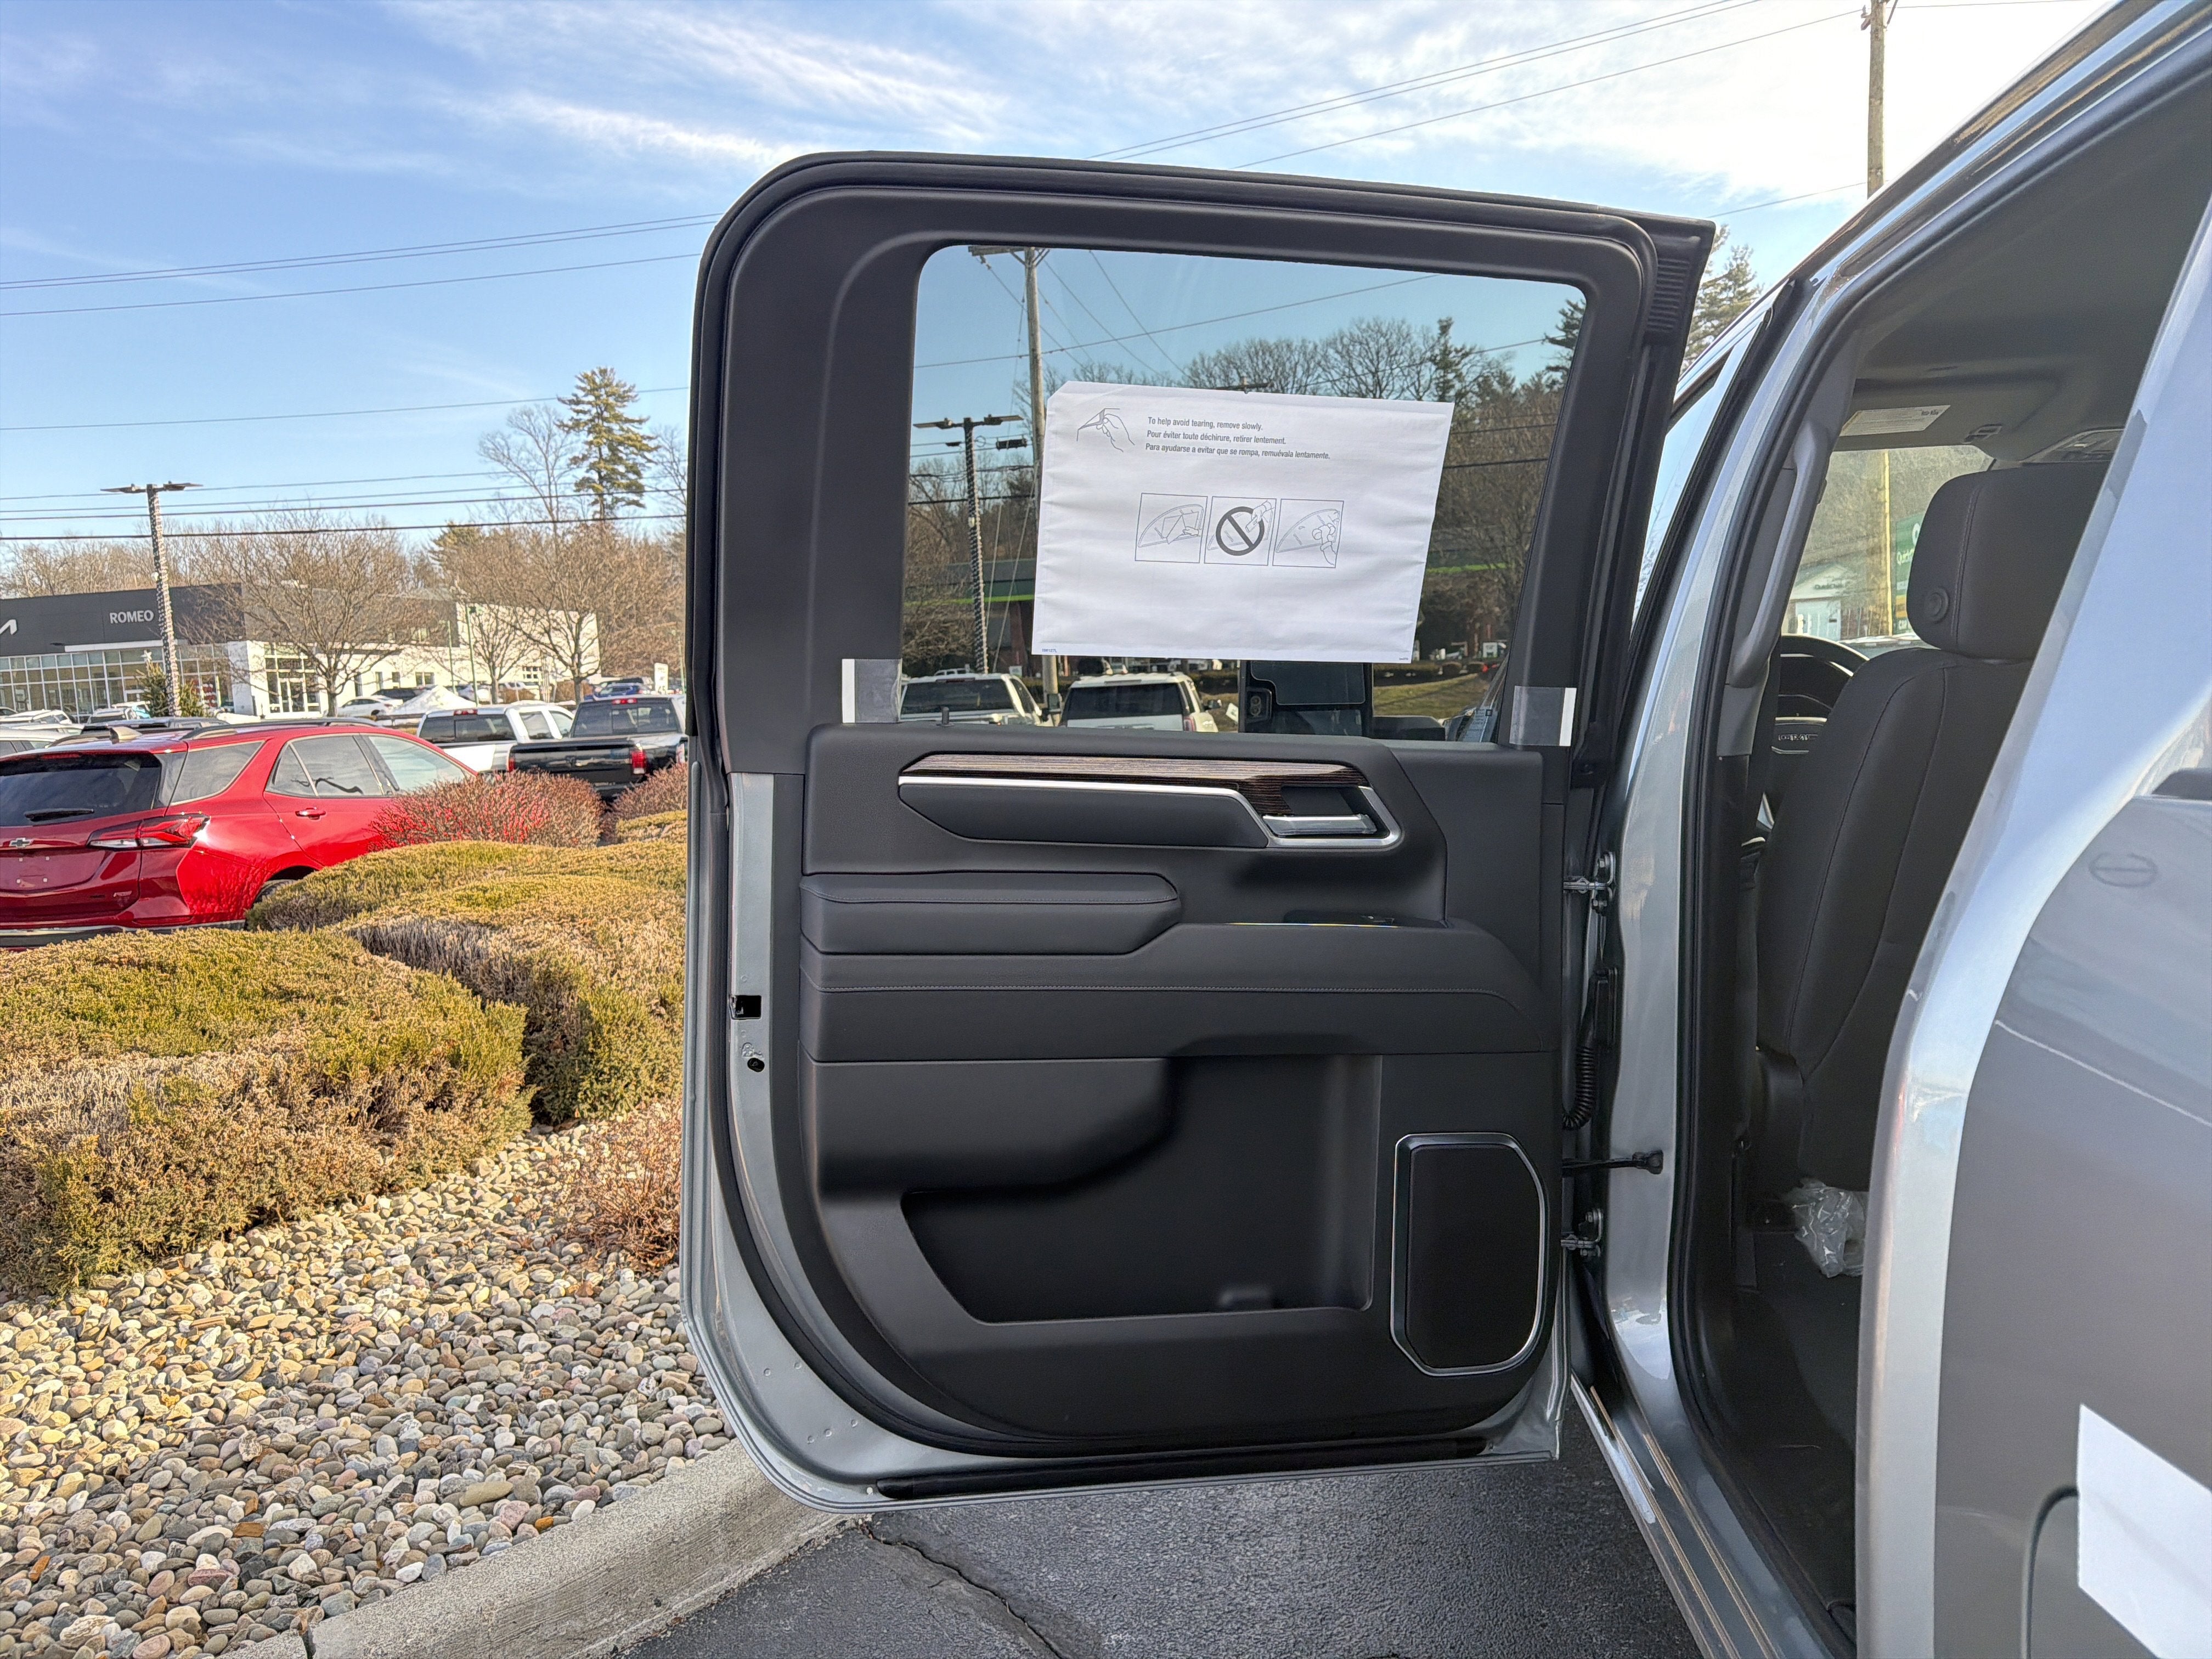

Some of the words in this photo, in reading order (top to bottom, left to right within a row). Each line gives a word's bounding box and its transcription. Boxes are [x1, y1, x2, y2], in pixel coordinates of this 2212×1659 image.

[1148, 416, 1156, 425] To
[1158, 417, 1171, 427] help
[1192, 420, 1215, 430] tearing,
[1242, 422, 1263, 431] slowly.
[1163, 431, 1181, 439] éviter
[1183, 432, 1199, 441] toute
[1200, 433, 1232, 443] déchirure,
[1254, 436, 1286, 444] lentement.
[1146, 443, 1160, 451] Para
[1238, 449, 1260, 458] rompa,
[1261, 449, 1294, 458] remuévala
[1294, 450, 1330, 459] lentamente.
[109, 610, 154, 624] ROMEO
